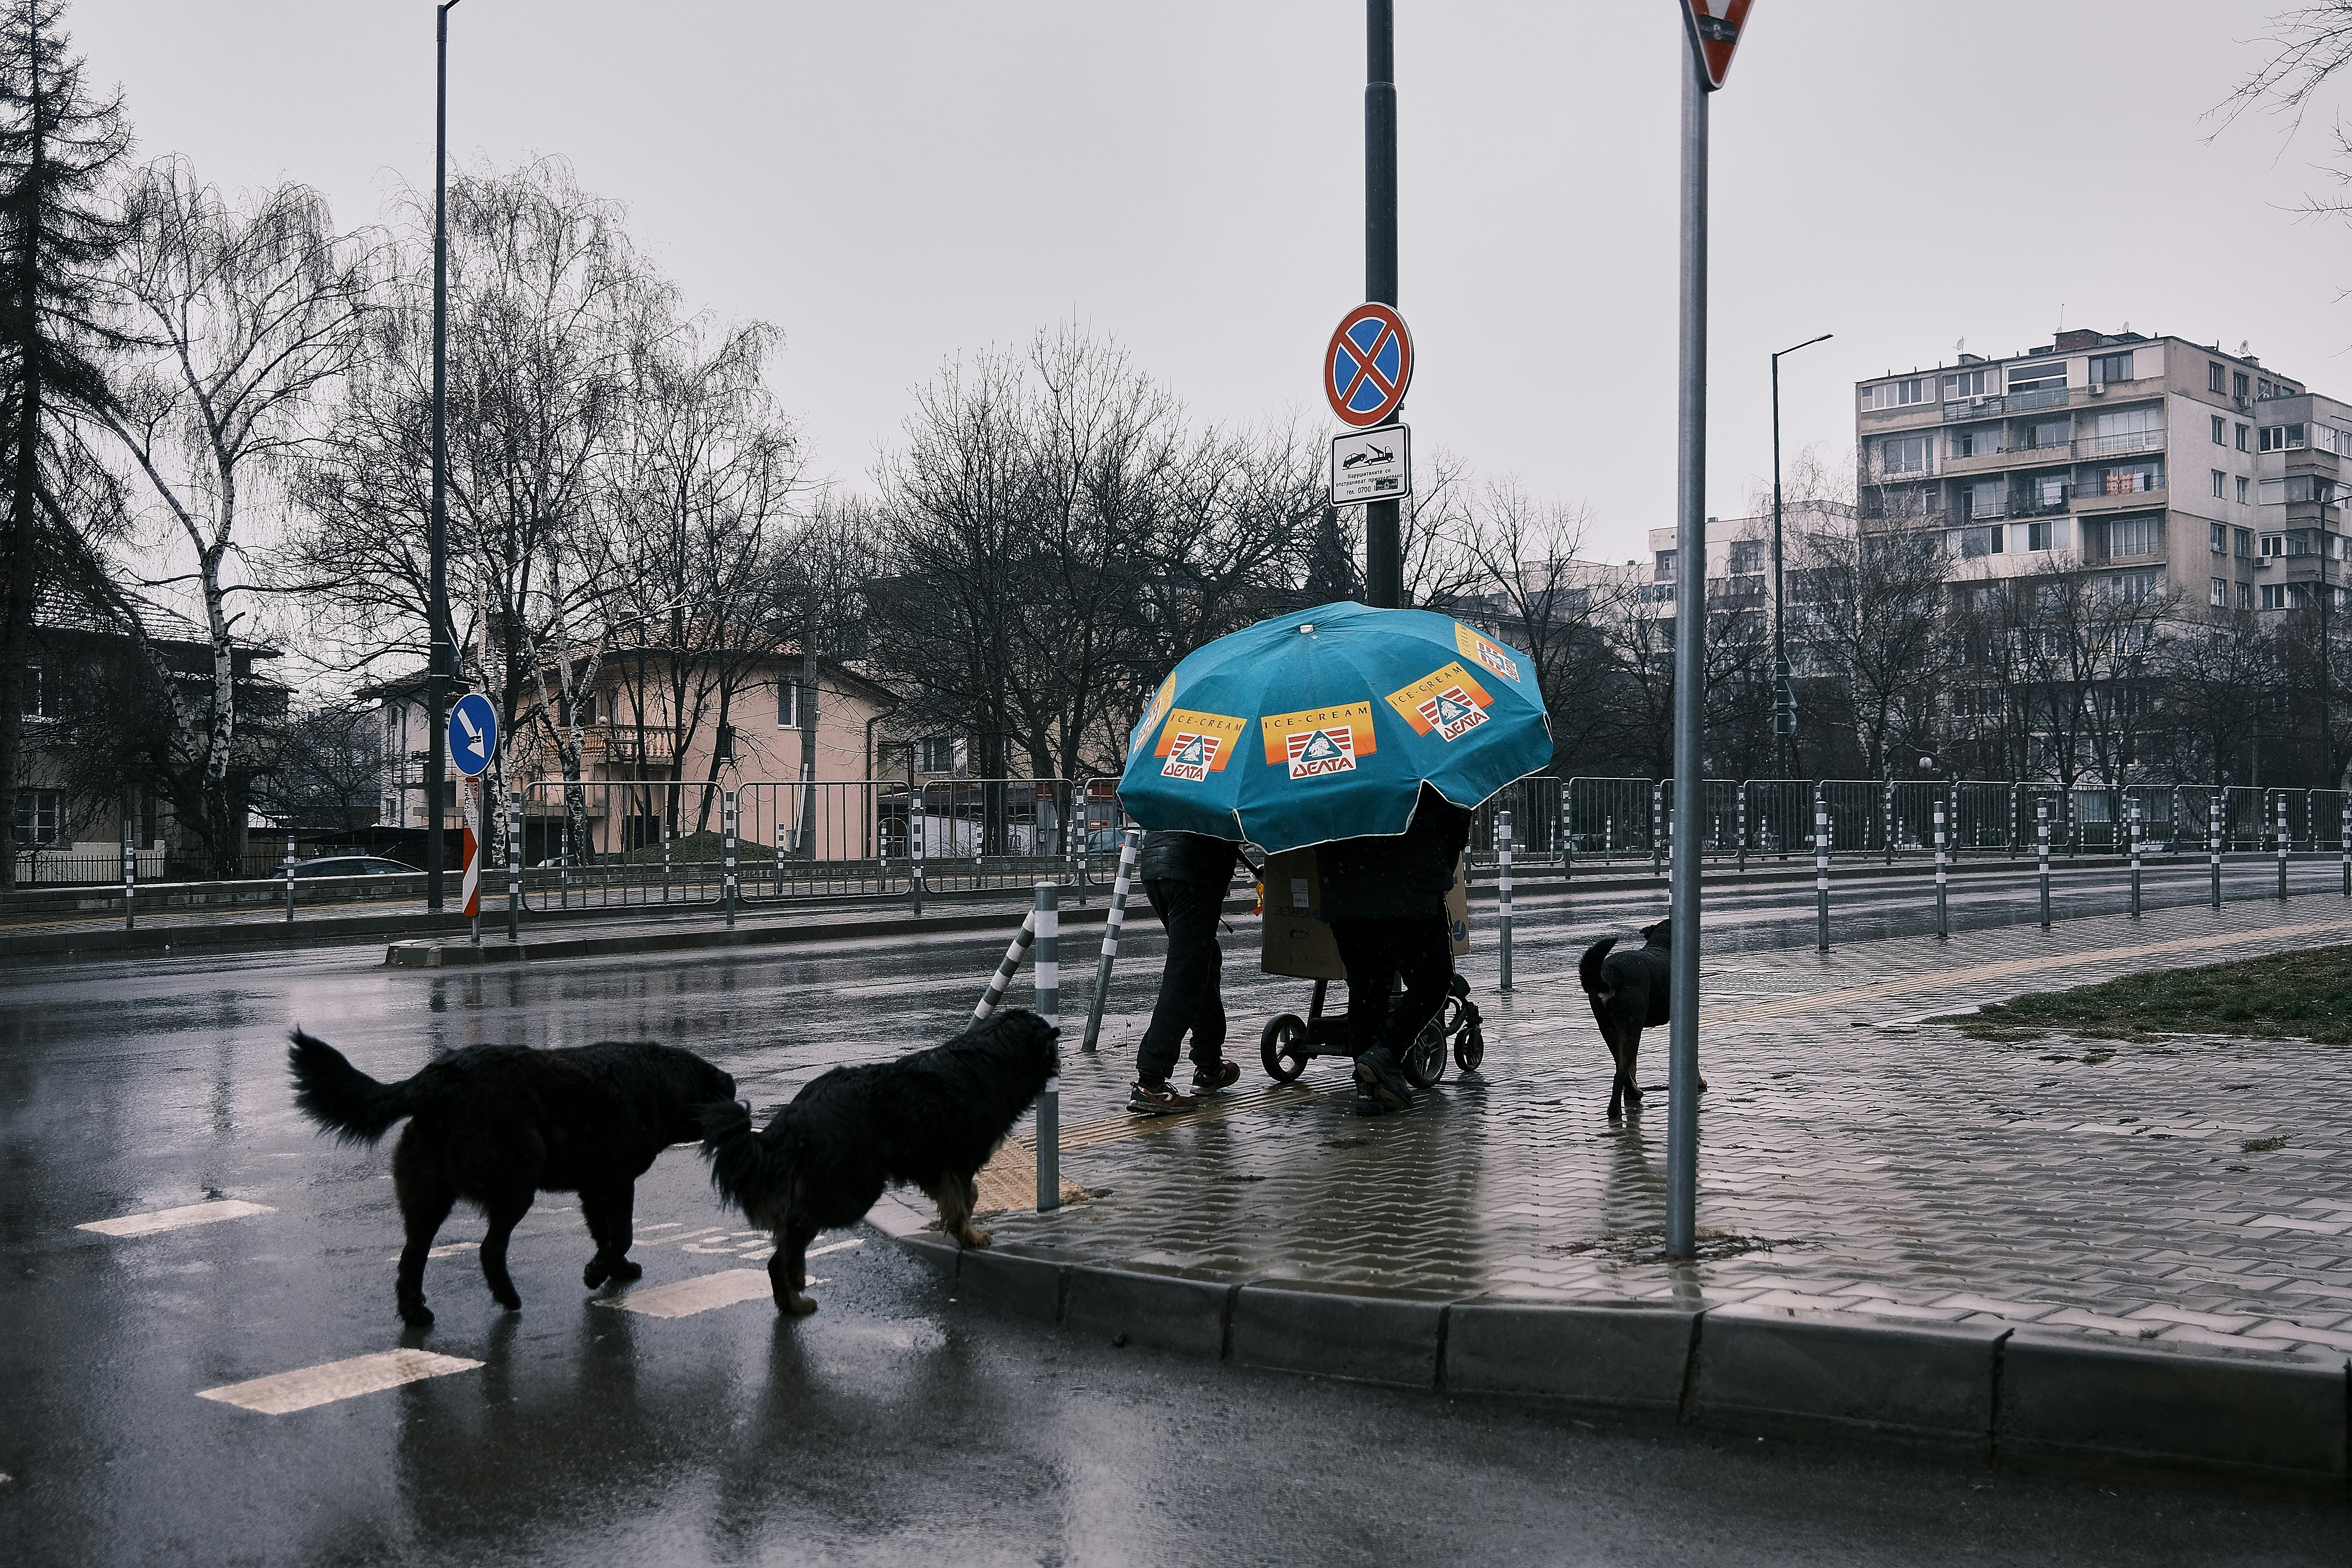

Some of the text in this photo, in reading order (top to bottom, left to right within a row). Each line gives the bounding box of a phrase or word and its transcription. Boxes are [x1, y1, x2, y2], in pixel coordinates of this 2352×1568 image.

[1348, 470, 1383, 479] Нарушителите
[1336, 479, 1366, 487] отстраняват
[1392, 666, 1463, 706] ICE-CREAM
[1170, 714, 1243, 731] ICE-CREAM
[1264, 707, 1367, 729] ICE-CREAM
[1275, 905, 1309, 917] GREE
